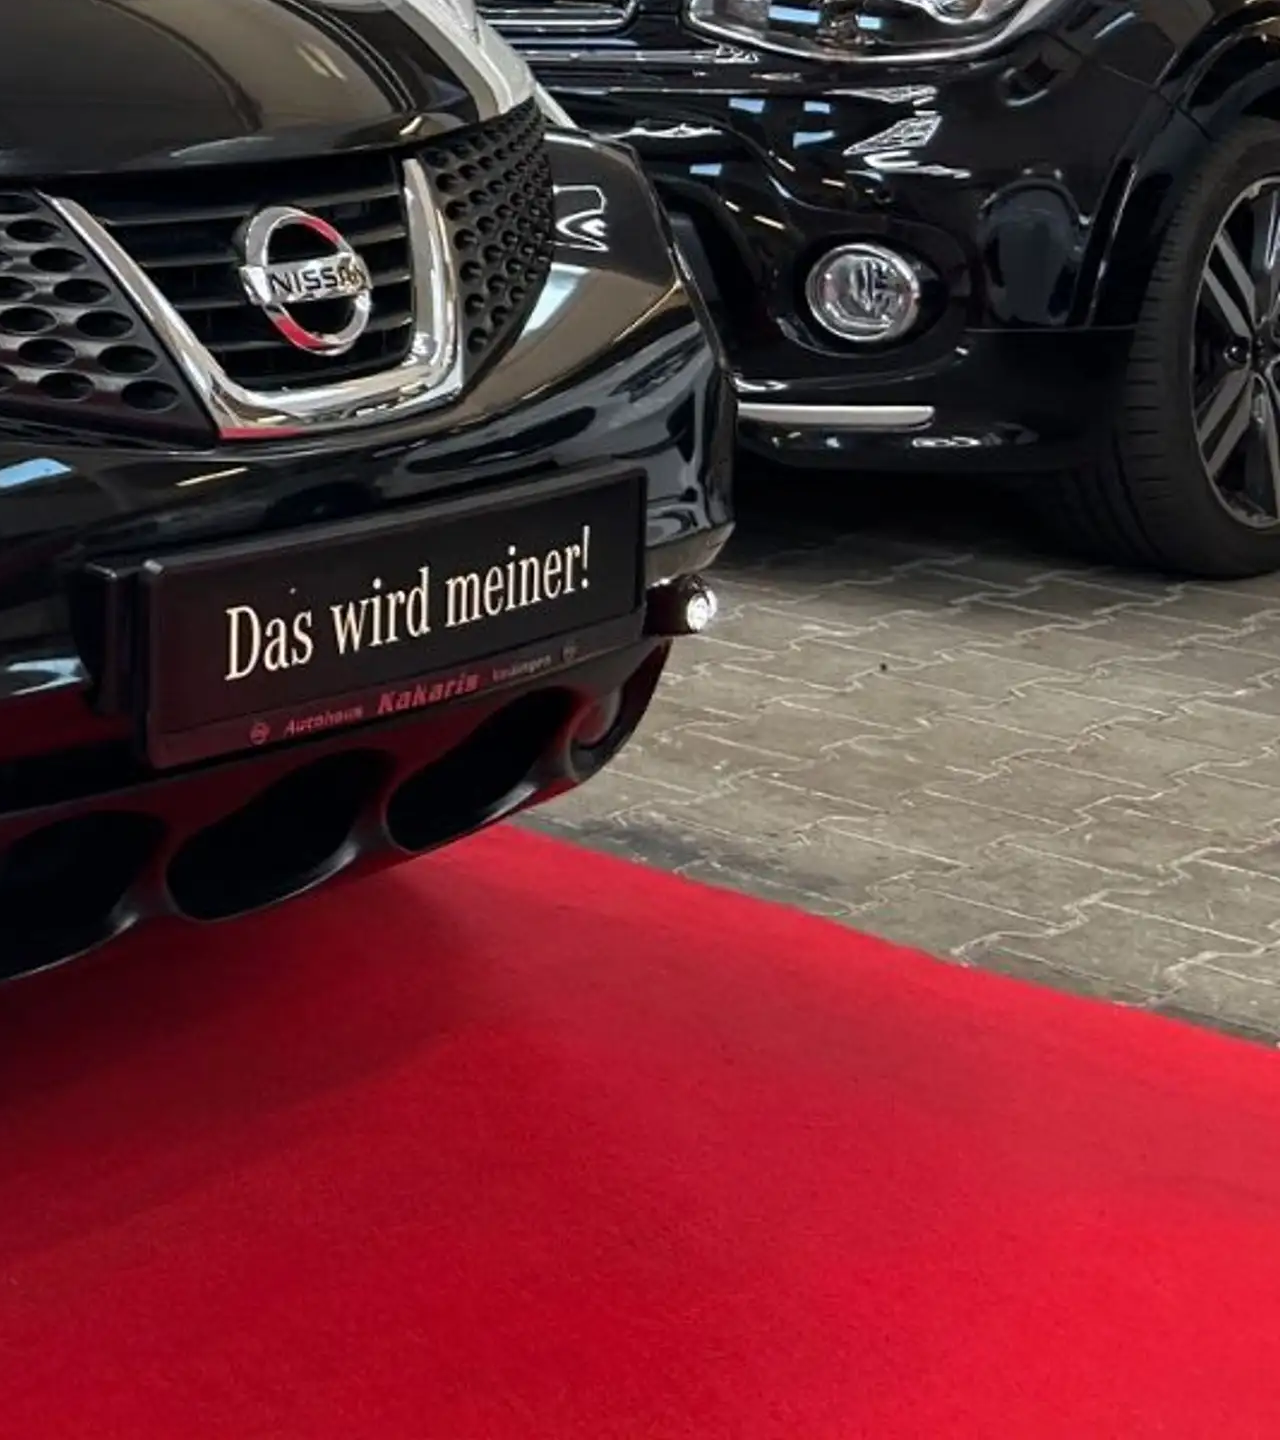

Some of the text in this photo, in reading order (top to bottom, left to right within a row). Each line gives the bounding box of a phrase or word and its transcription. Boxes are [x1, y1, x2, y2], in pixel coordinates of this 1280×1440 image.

[224, 524, 591, 682] Das wird meiner!
